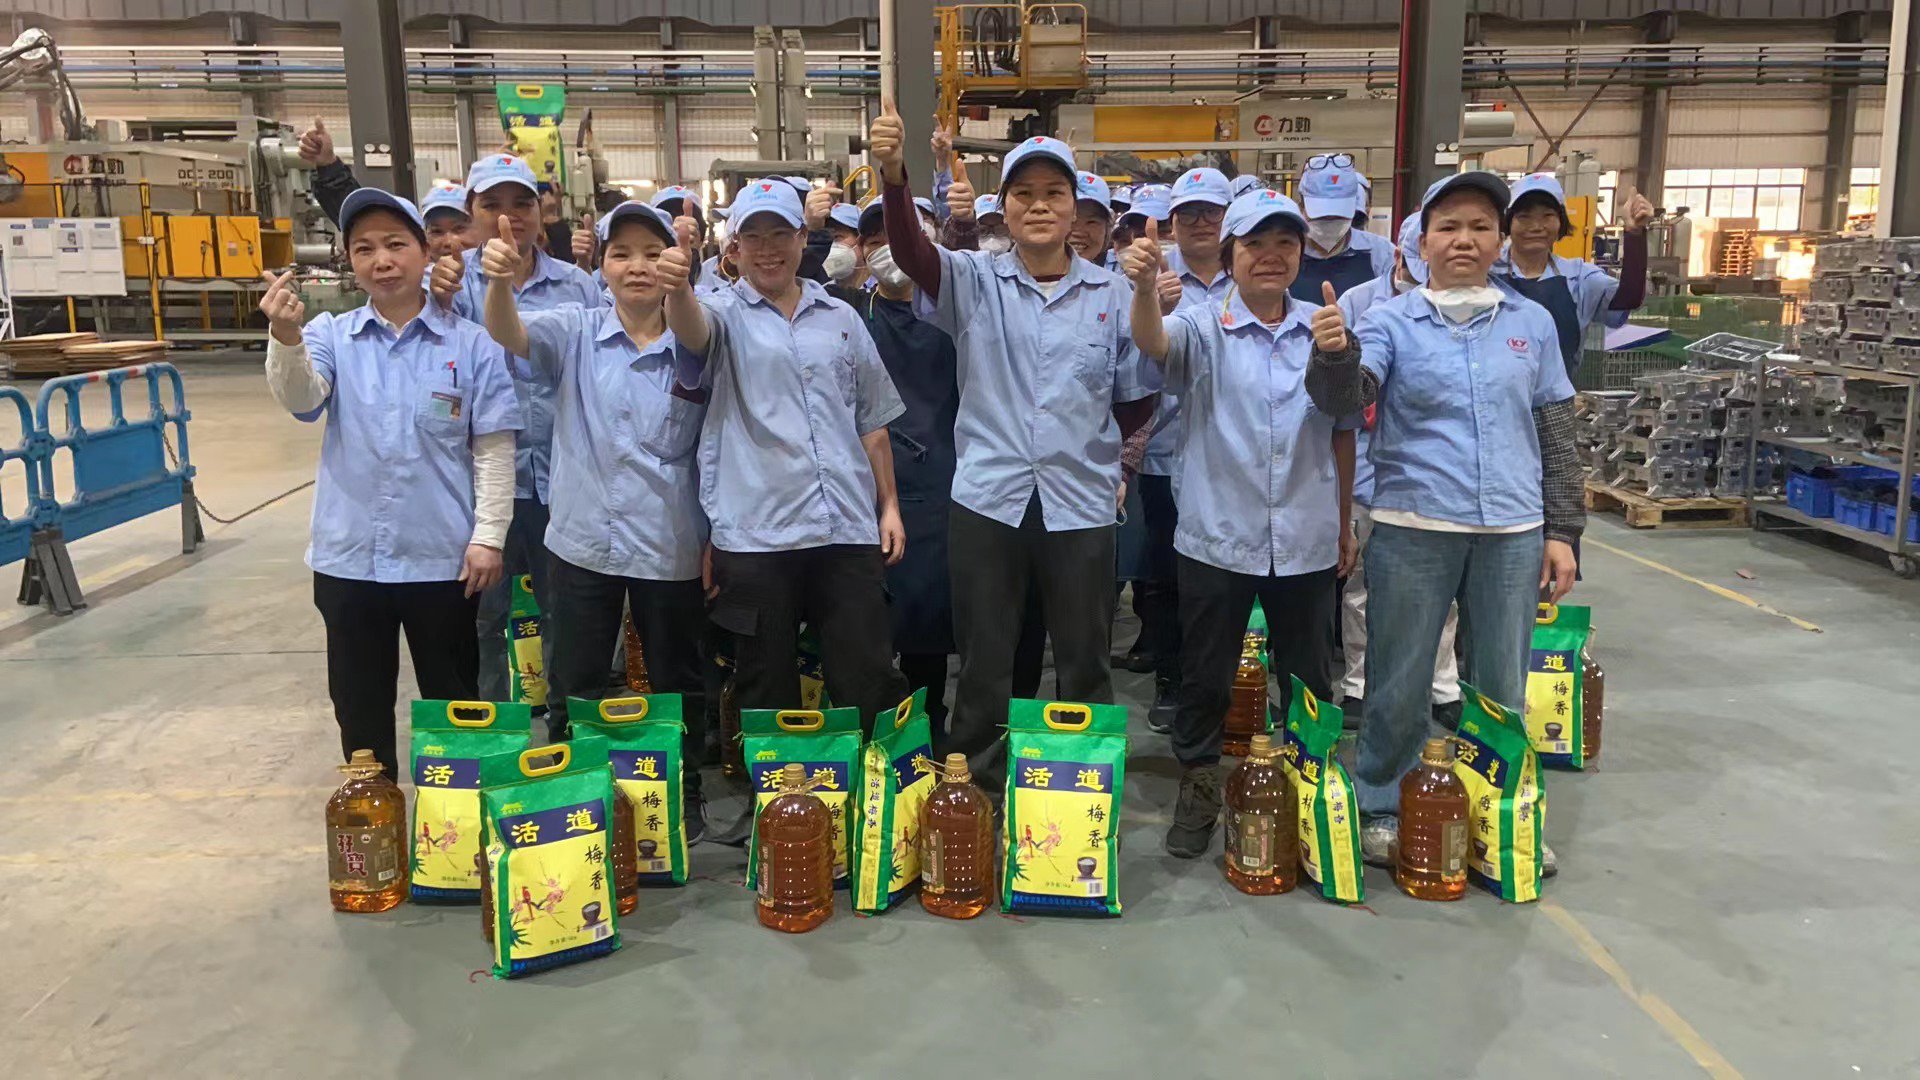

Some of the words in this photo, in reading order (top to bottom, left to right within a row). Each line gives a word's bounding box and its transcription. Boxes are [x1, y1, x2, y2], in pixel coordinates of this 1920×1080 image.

[1278, 117, 1311, 133] 力勤
[208, 170, 233, 180] 200
[518, 620, 539, 636] 活
[1542, 655, 1567, 672] 道
[1553, 681, 1569, 716] 梅香
[632, 756, 659, 779] 道
[1023, 766, 1105, 792] 活道
[642, 791, 664, 832] 梅香
[510, 808, 599, 845] 活道
[1087, 803, 1106, 849] 梅香
[585, 844, 604, 891] 梅香
